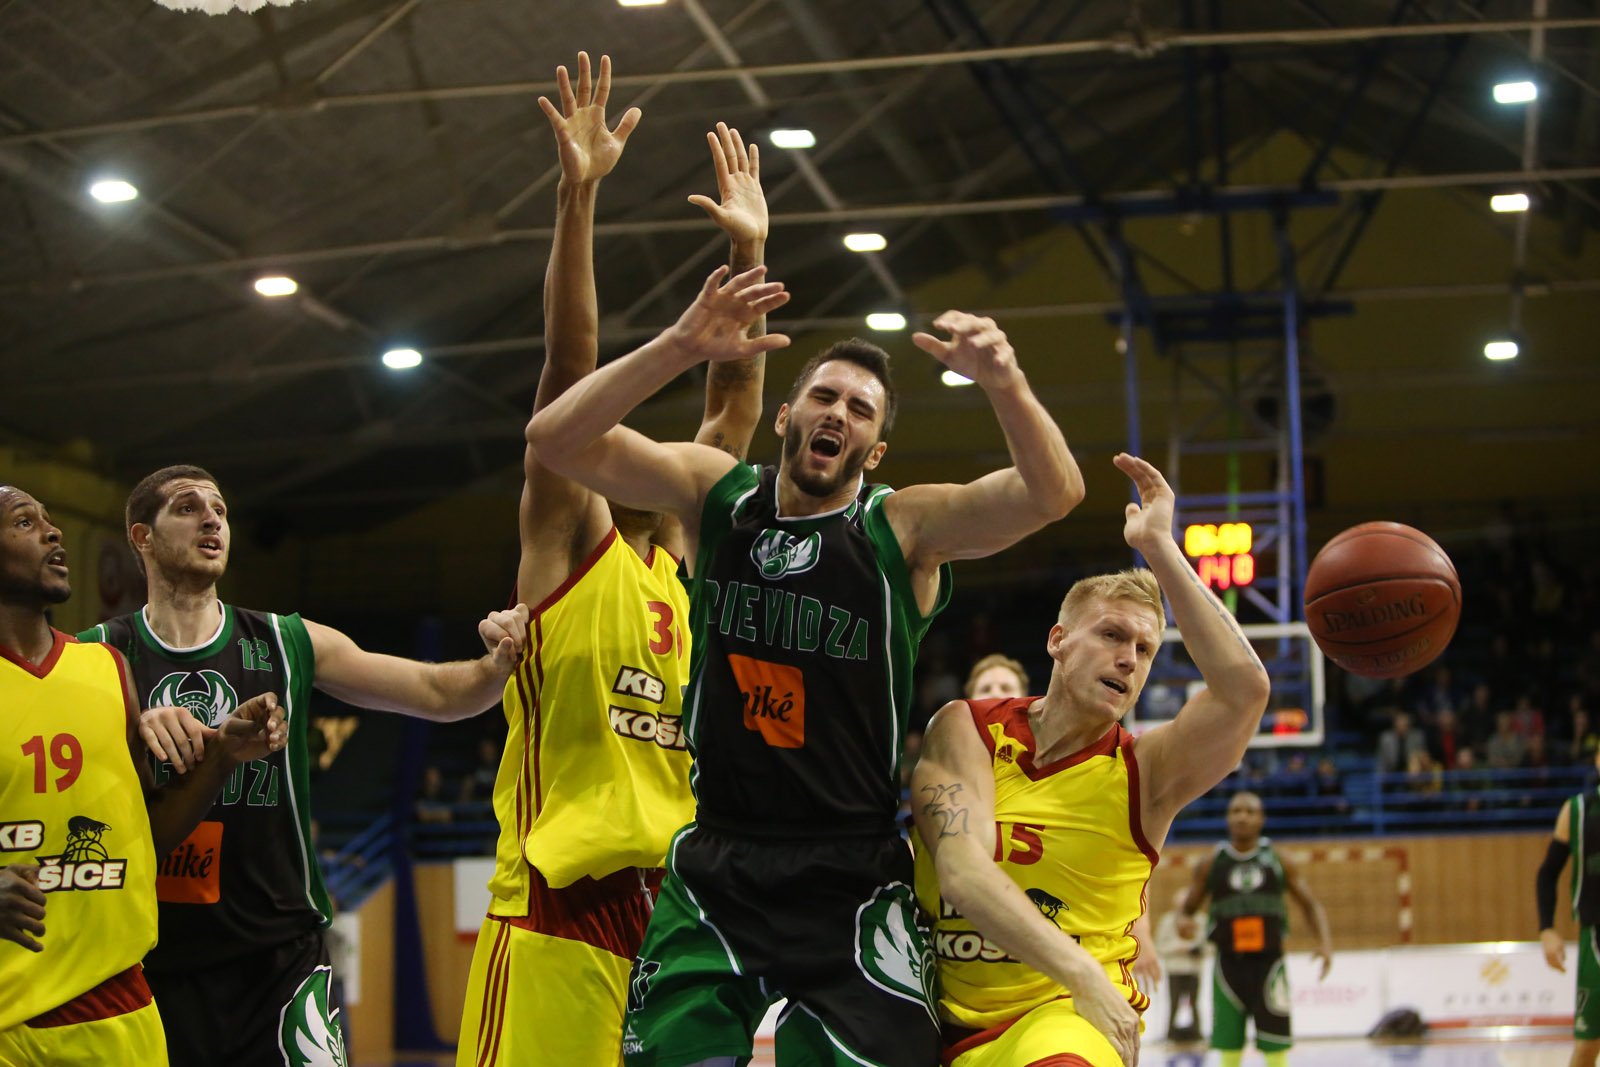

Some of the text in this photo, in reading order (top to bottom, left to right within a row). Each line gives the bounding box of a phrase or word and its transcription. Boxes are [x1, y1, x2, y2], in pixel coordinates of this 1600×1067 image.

[646, 600, 683, 660] 3
[705, 578, 869, 661] IEVIDZA
[1322, 592, 1426, 634] SPALDING
[237, 637, 274, 672] 12
[615, 668, 664, 703] KB
[609, 707, 687, 748] KOŠI
[21, 733, 84, 794] 19
[38, 858, 123, 890] ŠICE
